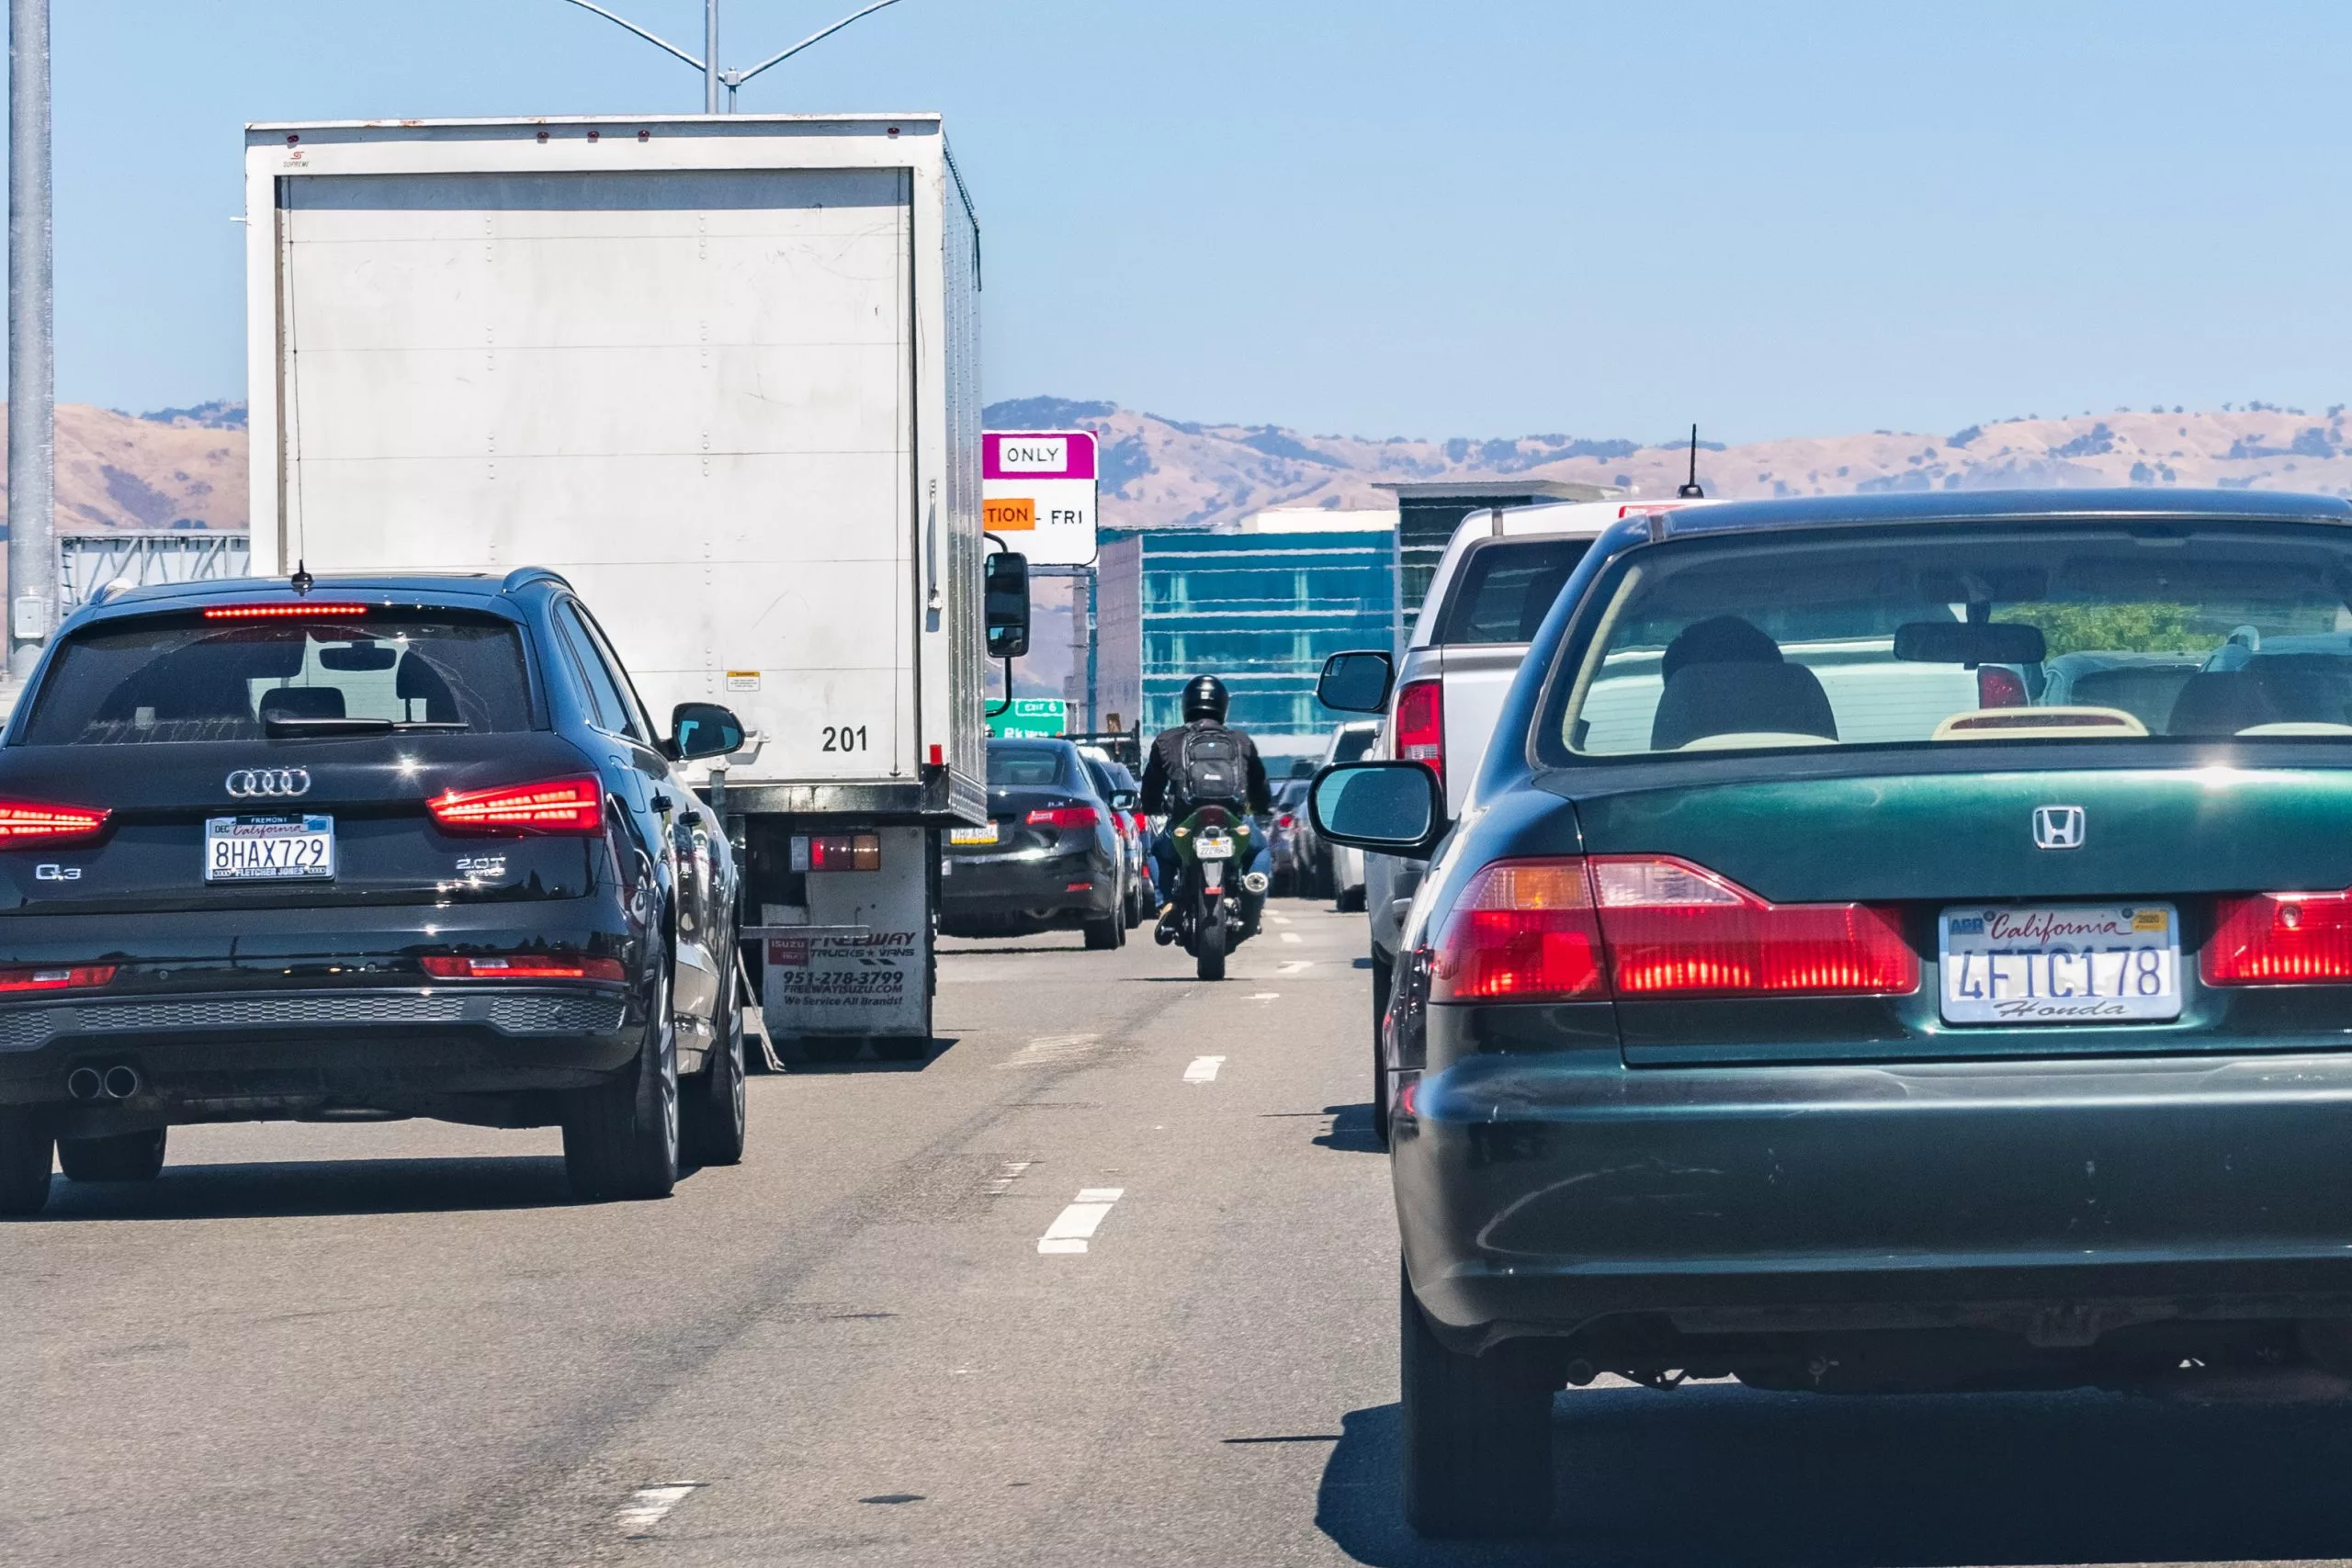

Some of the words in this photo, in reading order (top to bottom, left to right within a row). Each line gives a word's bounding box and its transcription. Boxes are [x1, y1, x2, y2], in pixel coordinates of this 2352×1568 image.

[1007, 448, 1058, 462] ONLY
[983, 507, 1028, 523] TION
[1051, 510, 1082, 525] FRI
[1048, 702, 1057, 713] 6
[822, 725, 866, 752] 201
[215, 825, 230, 834] DEC
[232, 823, 309, 839] California
[216, 839, 323, 868] 8HAX729
[456, 857, 506, 870] 2.0T
[36, 863, 82, 881] Q3
[236, 867, 277, 877] FLETCHER
[277, 866, 304, 876] JONES
[1991, 912, 2132, 945] California
[771, 940, 805, 948] ISUZU
[810, 949, 865, 957] TRUCKS
[879, 948, 915, 957] VANS
[784, 971, 904, 985] 951-278-3799
[784, 984, 902, 994] FREEWAYISUZU.COM
[785, 996, 801, 1005] We
[803, 996, 842, 1006] Service
[842, 997, 859, 1006] All
[861, 996, 903, 1006] Brands!
[1994, 1000, 2131, 1018] Honda
